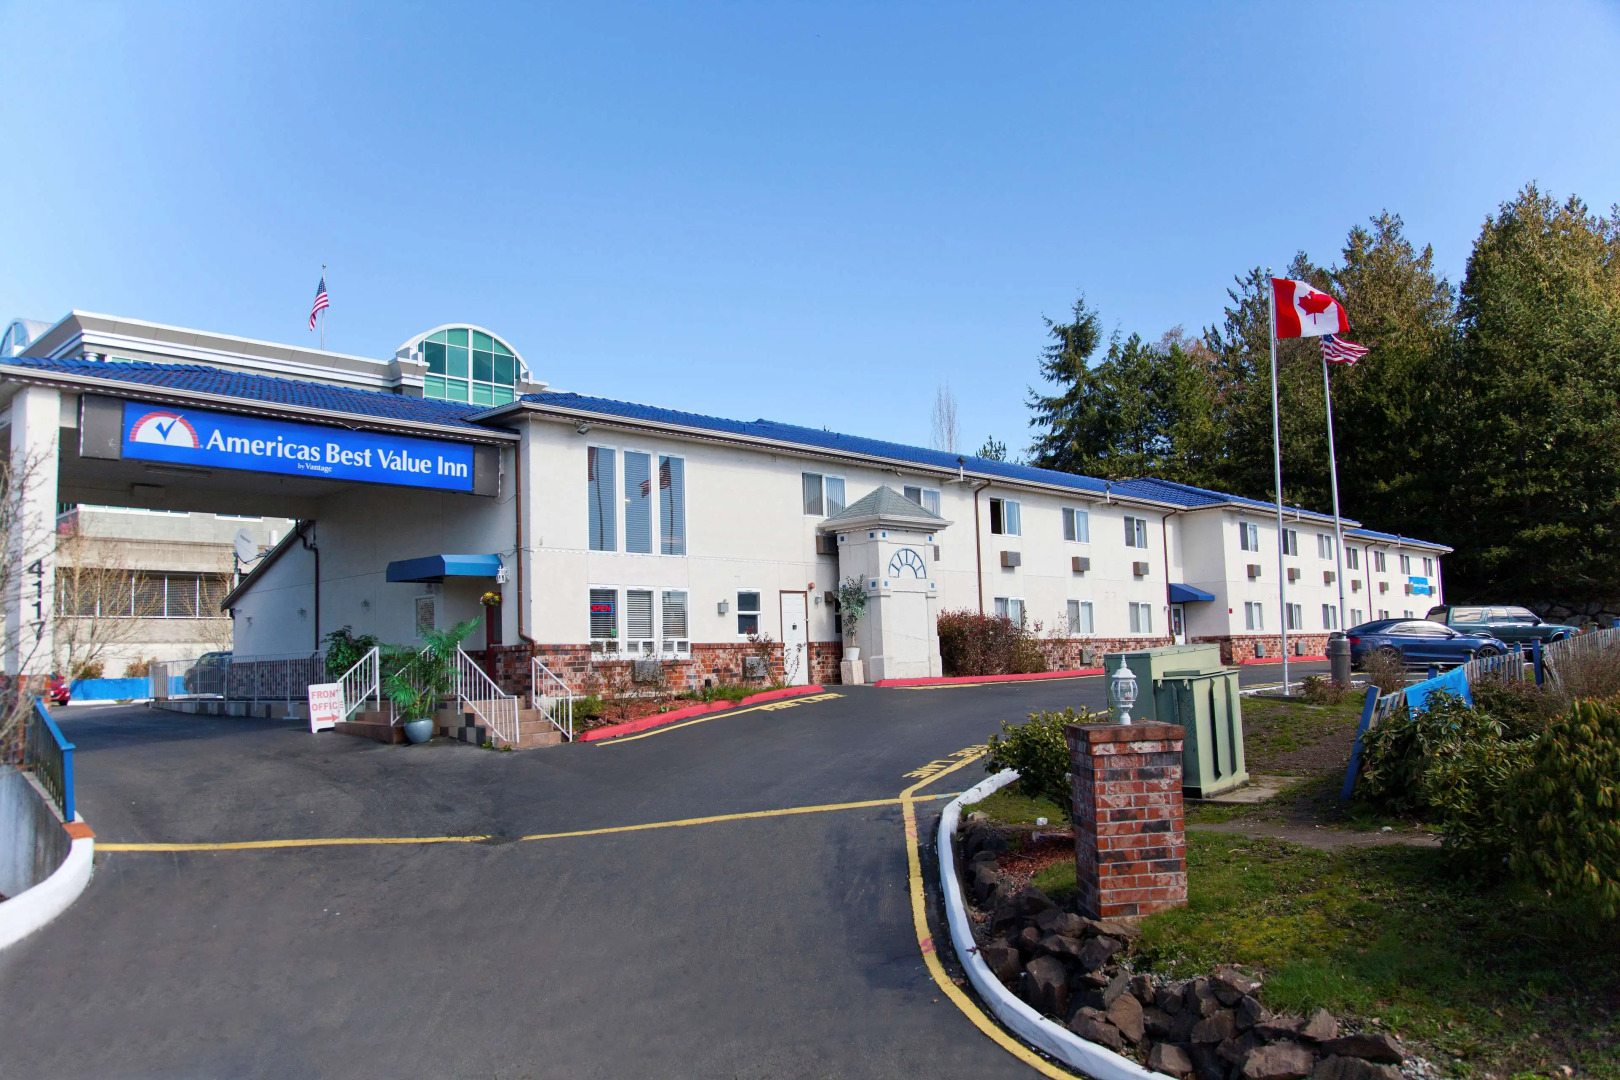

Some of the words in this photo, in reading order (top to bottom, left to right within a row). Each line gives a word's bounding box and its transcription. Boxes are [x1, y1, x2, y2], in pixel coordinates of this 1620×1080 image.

[206, 429, 320, 462] Americas
[326, 443, 372, 468] Best
[377, 448, 432, 474] Value
[437, 454, 468, 478] Inn
[297, 462, 305, 470] by
[305, 463, 332, 473] Vantage
[28, 559, 45, 642] 4117
